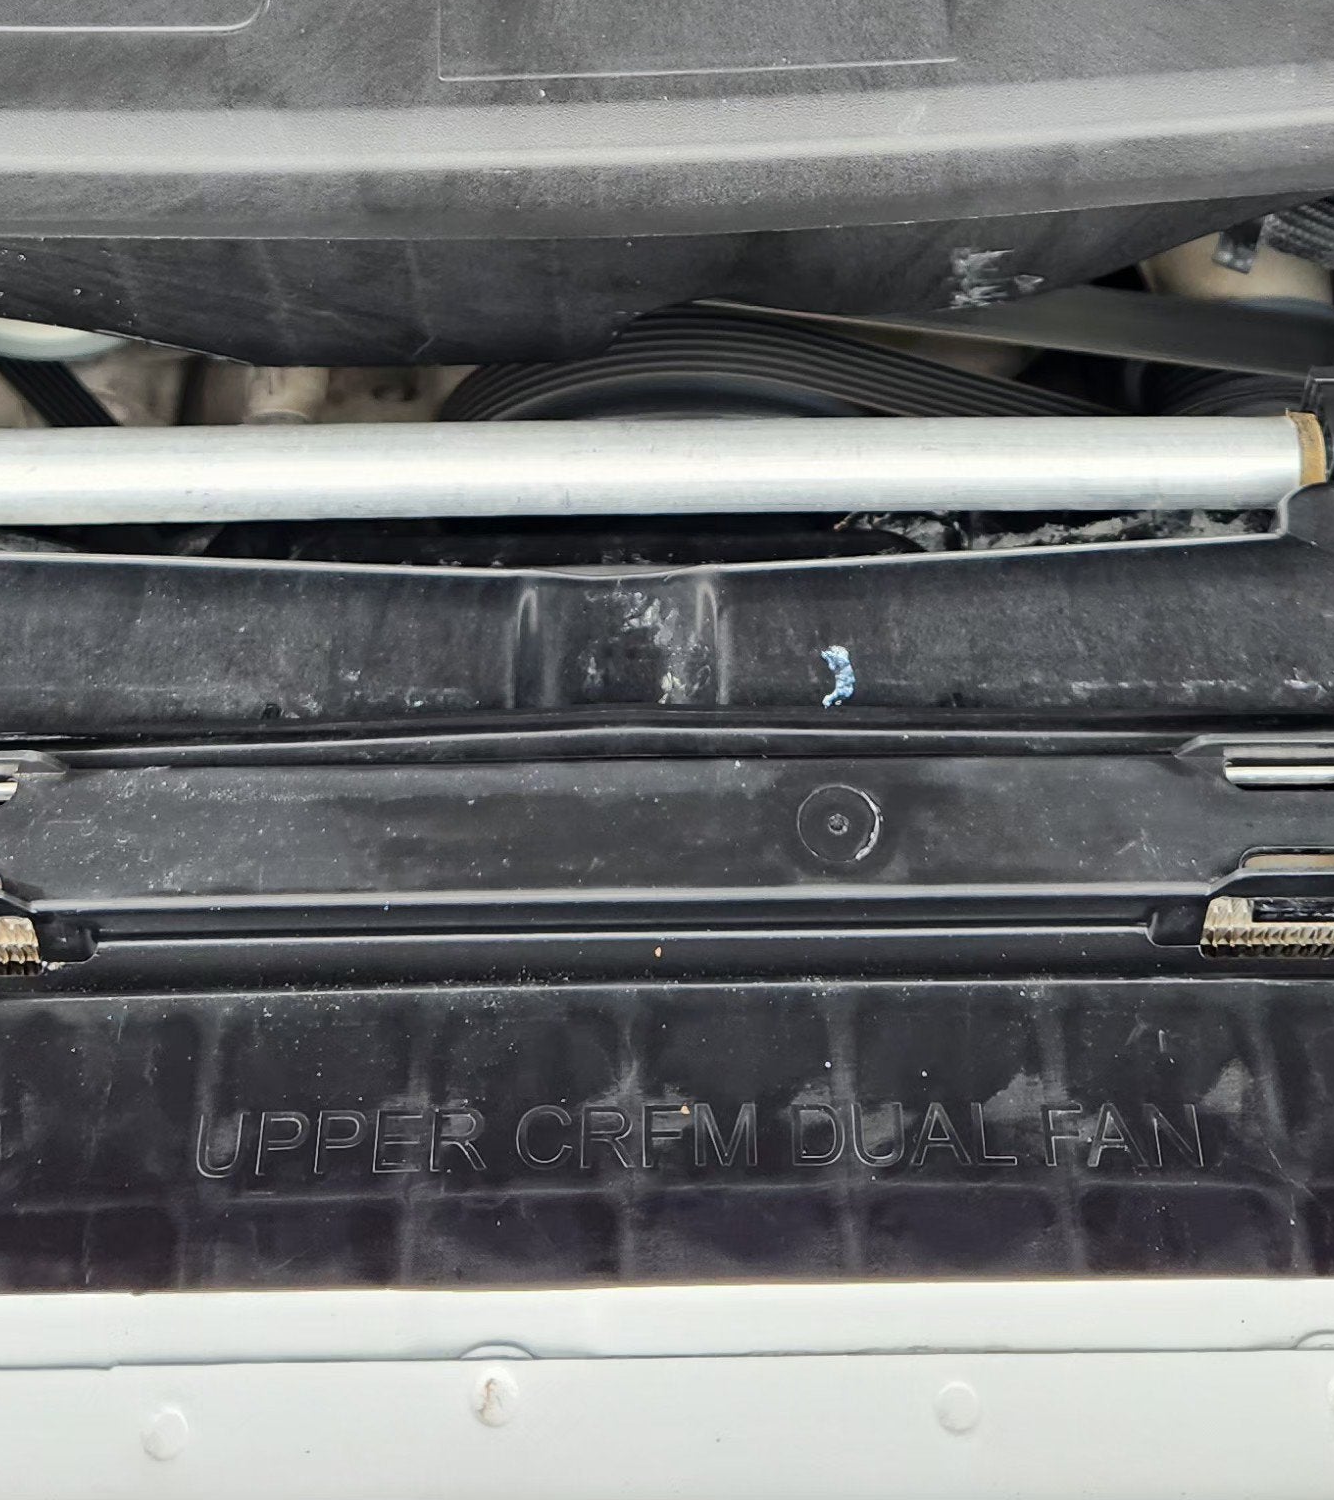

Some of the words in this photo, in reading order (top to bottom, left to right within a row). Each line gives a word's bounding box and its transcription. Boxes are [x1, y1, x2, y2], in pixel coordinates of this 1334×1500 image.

[195, 1107, 487, 1179] UPPER
[515, 1102, 758, 1171] CRFM
[790, 1102, 1018, 1168] DUAL
[1040, 1102, 1205, 1168] FAN
